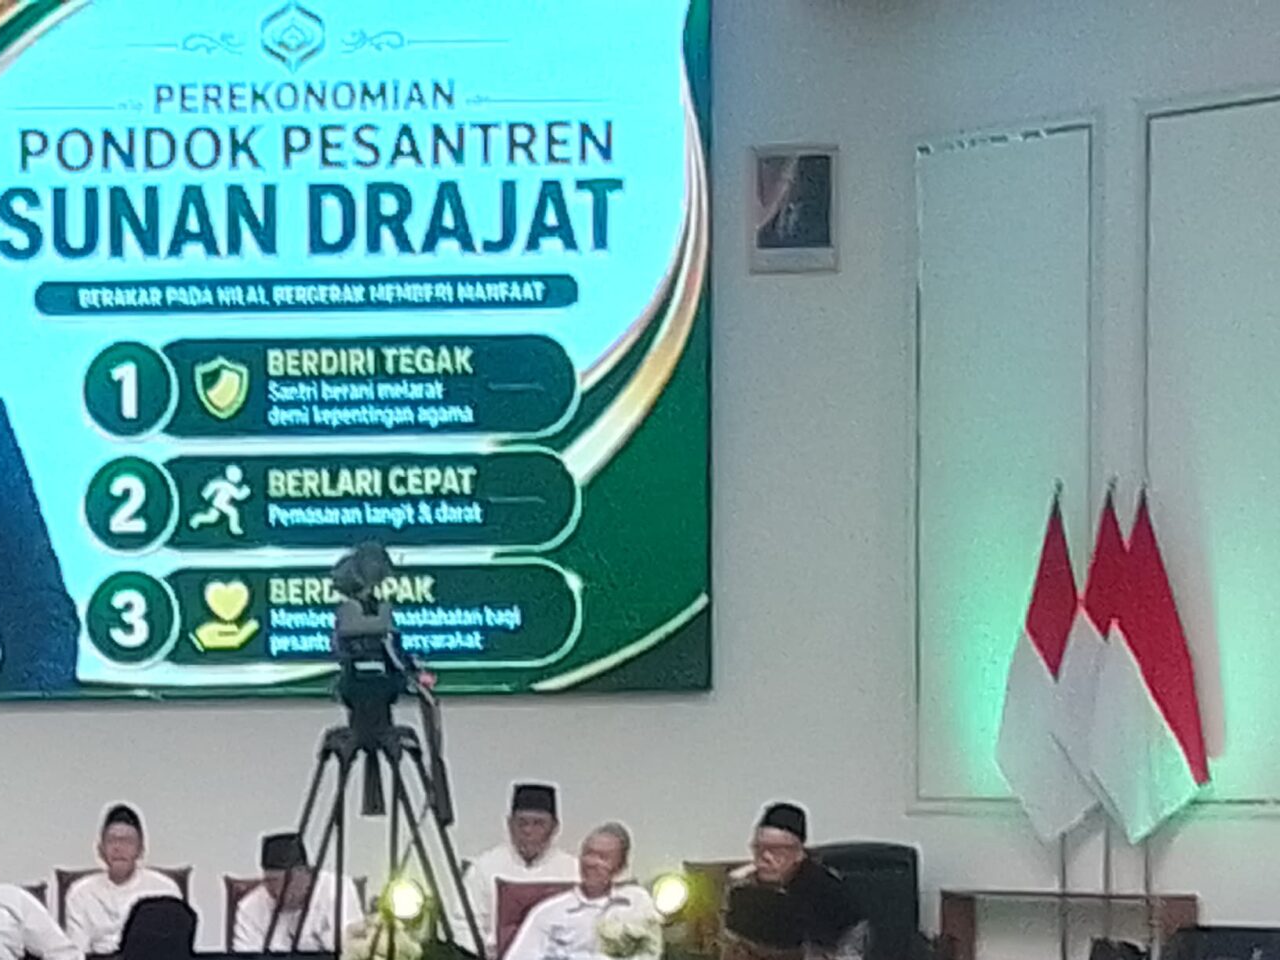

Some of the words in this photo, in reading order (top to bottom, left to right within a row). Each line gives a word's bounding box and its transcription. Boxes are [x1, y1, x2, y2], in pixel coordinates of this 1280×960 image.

[153, 79, 456, 114] PEREKONOMIAN
[19, 126, 263, 173] PONDOK
[283, 120, 614, 169] PESANTREN
[306, 178, 623, 256] DRAJAT
[165, 286, 214, 307] PADA
[267, 348, 375, 376] BERDIRI
[380, 345, 474, 375] TEGAK
[112, 361, 139, 420] 1
[268, 468, 382, 498] BERLARI
[388, 465, 477, 497] CEPAT
[109, 476, 147, 533] 2
[269, 576, 436, 604] BERDPAK
[109, 589, 149, 648] 3
